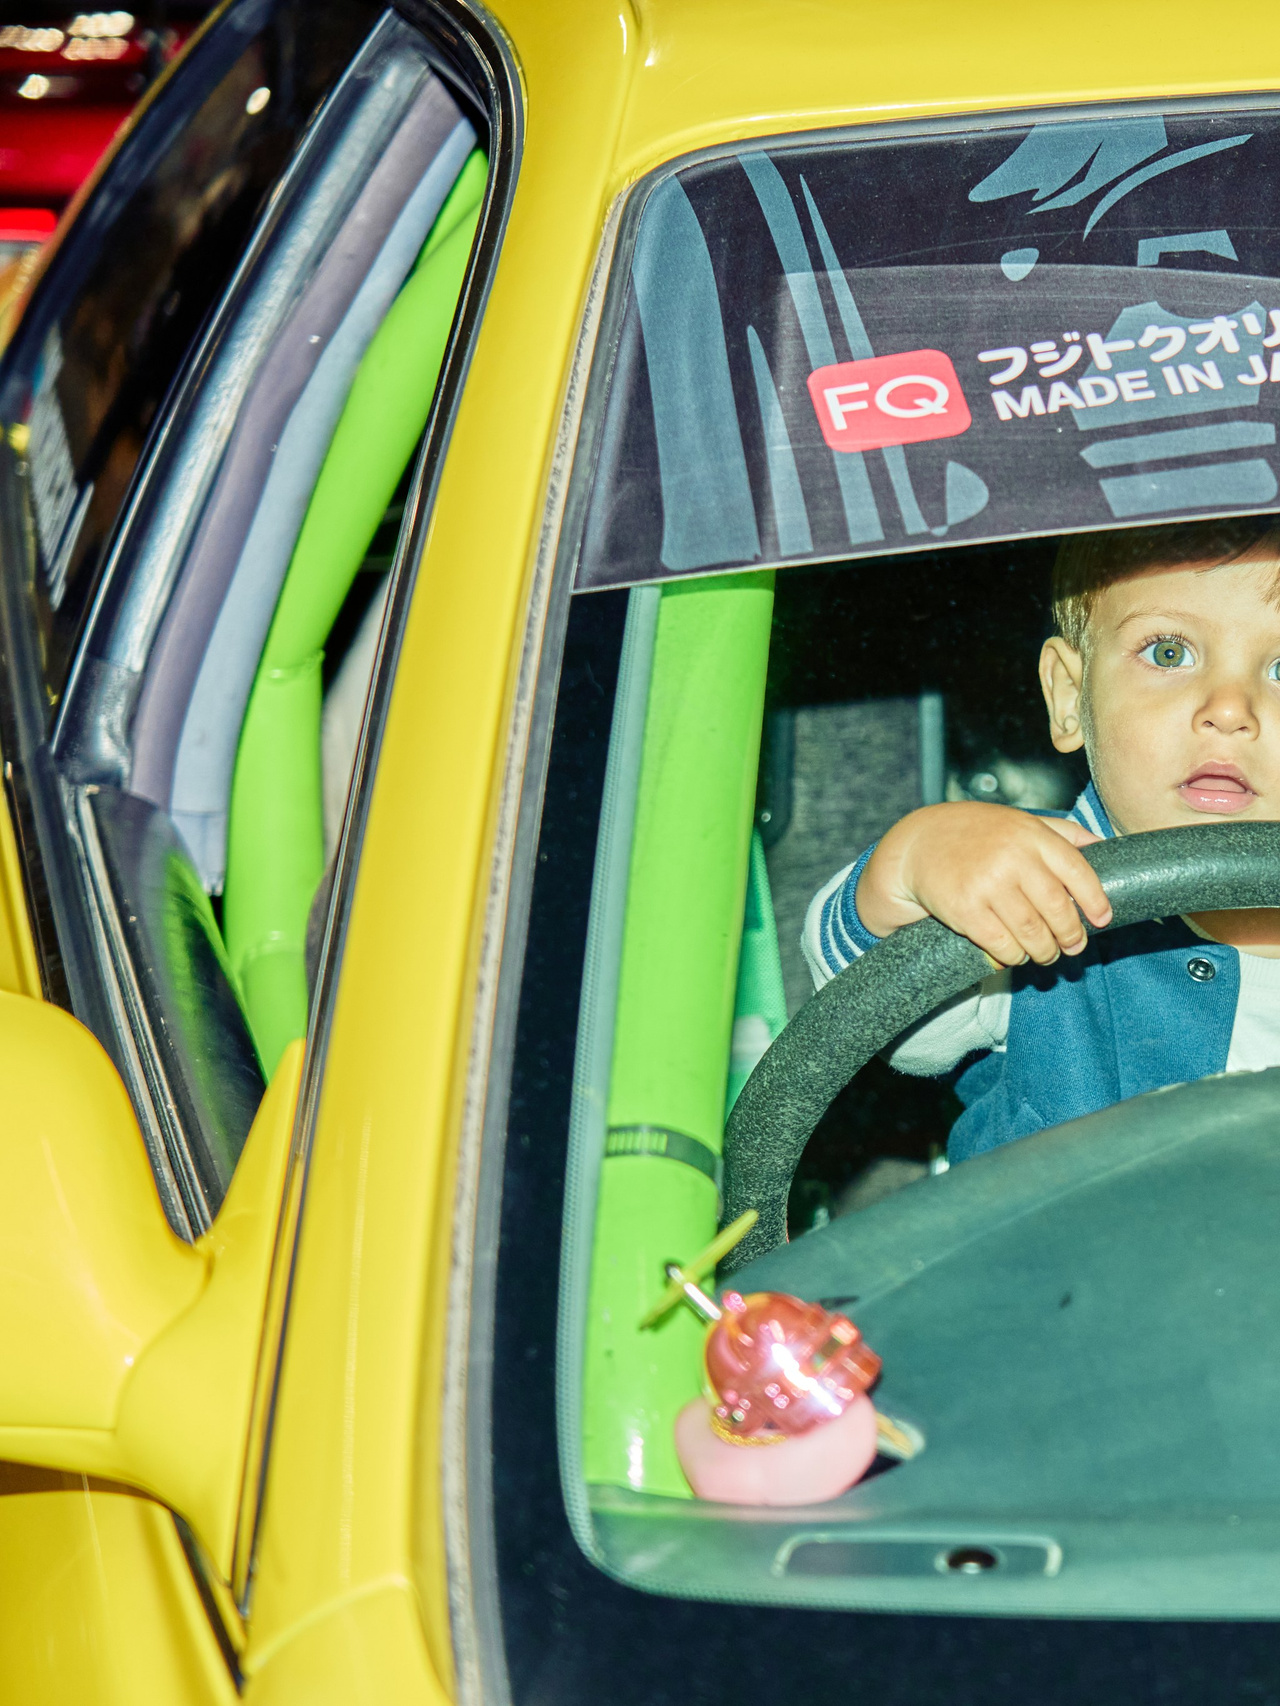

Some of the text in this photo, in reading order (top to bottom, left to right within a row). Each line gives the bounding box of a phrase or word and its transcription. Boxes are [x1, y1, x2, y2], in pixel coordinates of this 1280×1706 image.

[822, 374, 950, 432] FQ
[990, 368, 1157, 422] MADE
[1161, 359, 1226, 396] IN
